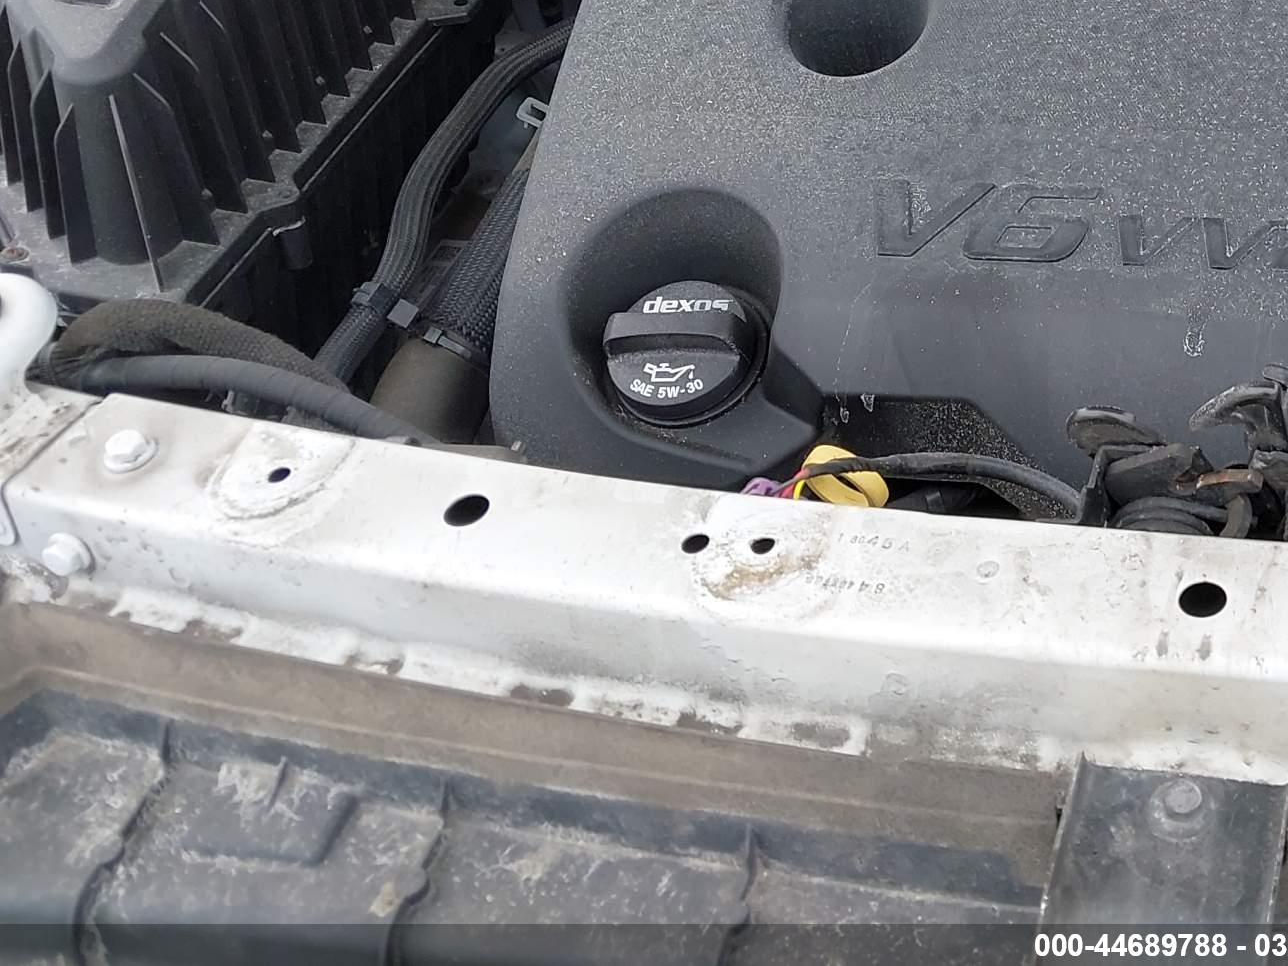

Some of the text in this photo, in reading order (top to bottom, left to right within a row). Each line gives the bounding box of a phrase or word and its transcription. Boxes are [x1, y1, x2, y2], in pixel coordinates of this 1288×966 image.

[877, 180, 1101, 263] V6
[643, 296, 730, 314] dexos
[629, 378, 704, 399] SAE 5W-30
